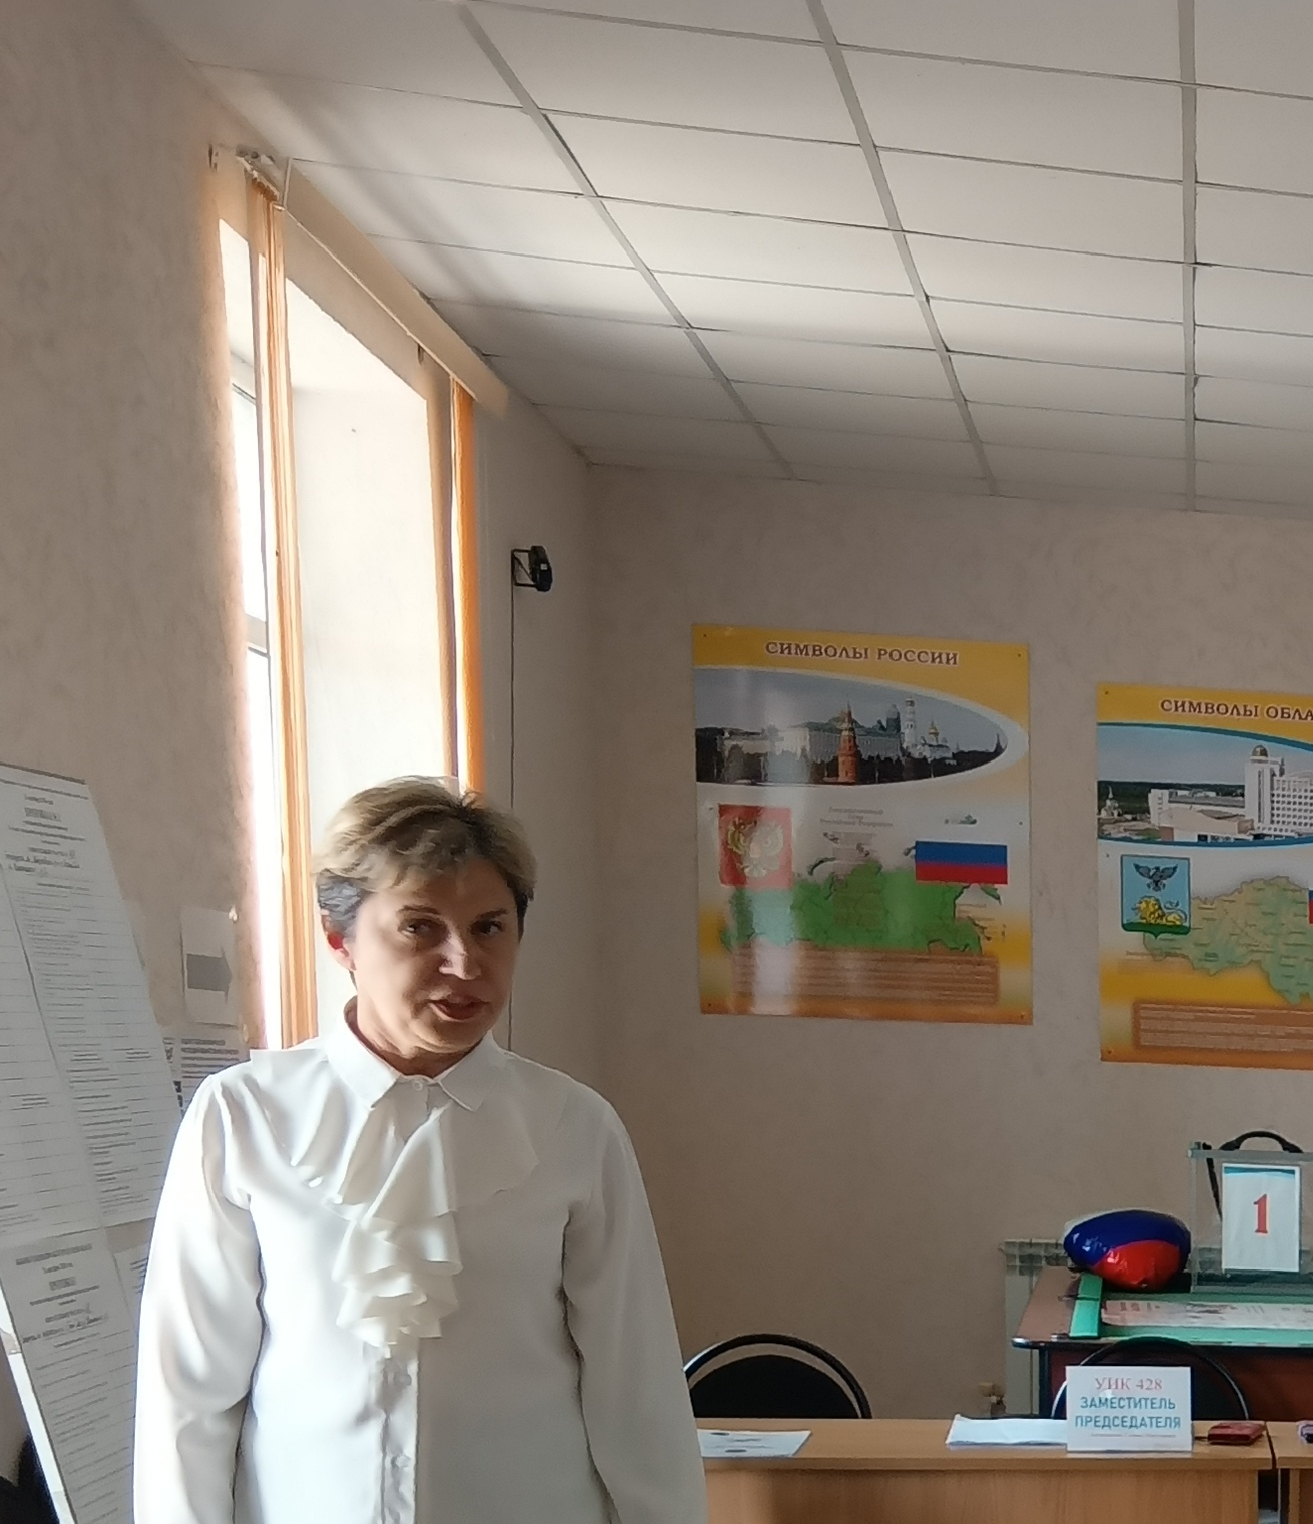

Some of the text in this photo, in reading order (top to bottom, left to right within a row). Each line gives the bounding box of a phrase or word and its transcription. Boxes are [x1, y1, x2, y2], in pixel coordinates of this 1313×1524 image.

[765, 641, 959, 666] СИМВОЛЫ РОССИИ
[1160, 699, 1259, 718] СИМВОЛЫ
[1253, 1193, 1268, 1234] 1
[1094, 1377, 1163, 1391] УИК 428
[1080, 1396, 1176, 1410] ЗАМЕСТИТЕЛЬ
[1075, 1415, 1181, 1430] ПРЕДСЕДАТЕЛЯ
